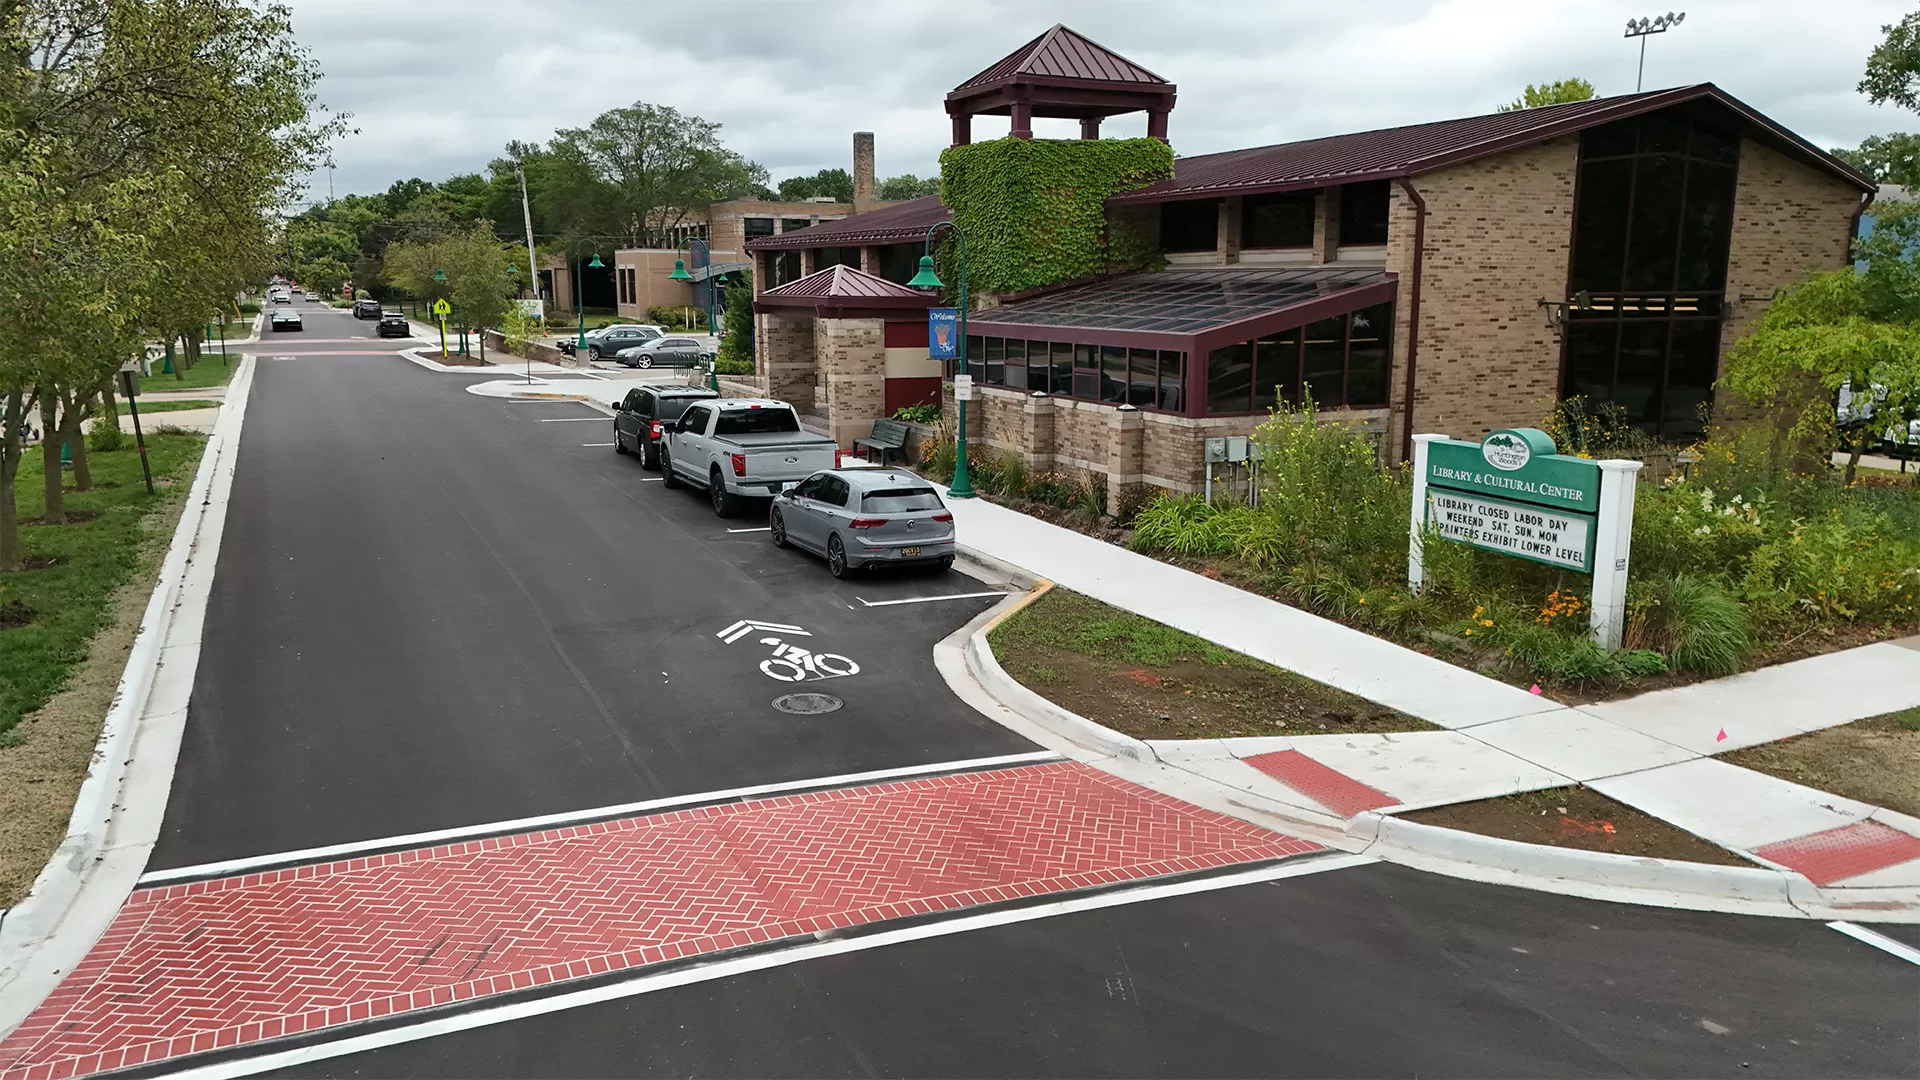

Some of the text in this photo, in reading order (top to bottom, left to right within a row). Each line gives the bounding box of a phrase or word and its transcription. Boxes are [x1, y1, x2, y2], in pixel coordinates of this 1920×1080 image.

[1473, 473, 1482, 484] &
[1437, 497, 1568, 532] LIBRARY CLOSED LABOR DAY
[1446, 511, 1558, 544] WEEKEND SAT. SUN. MON
[1439, 522, 1584, 563] PAINTERS EXHIBIT LOWER LEVEL
